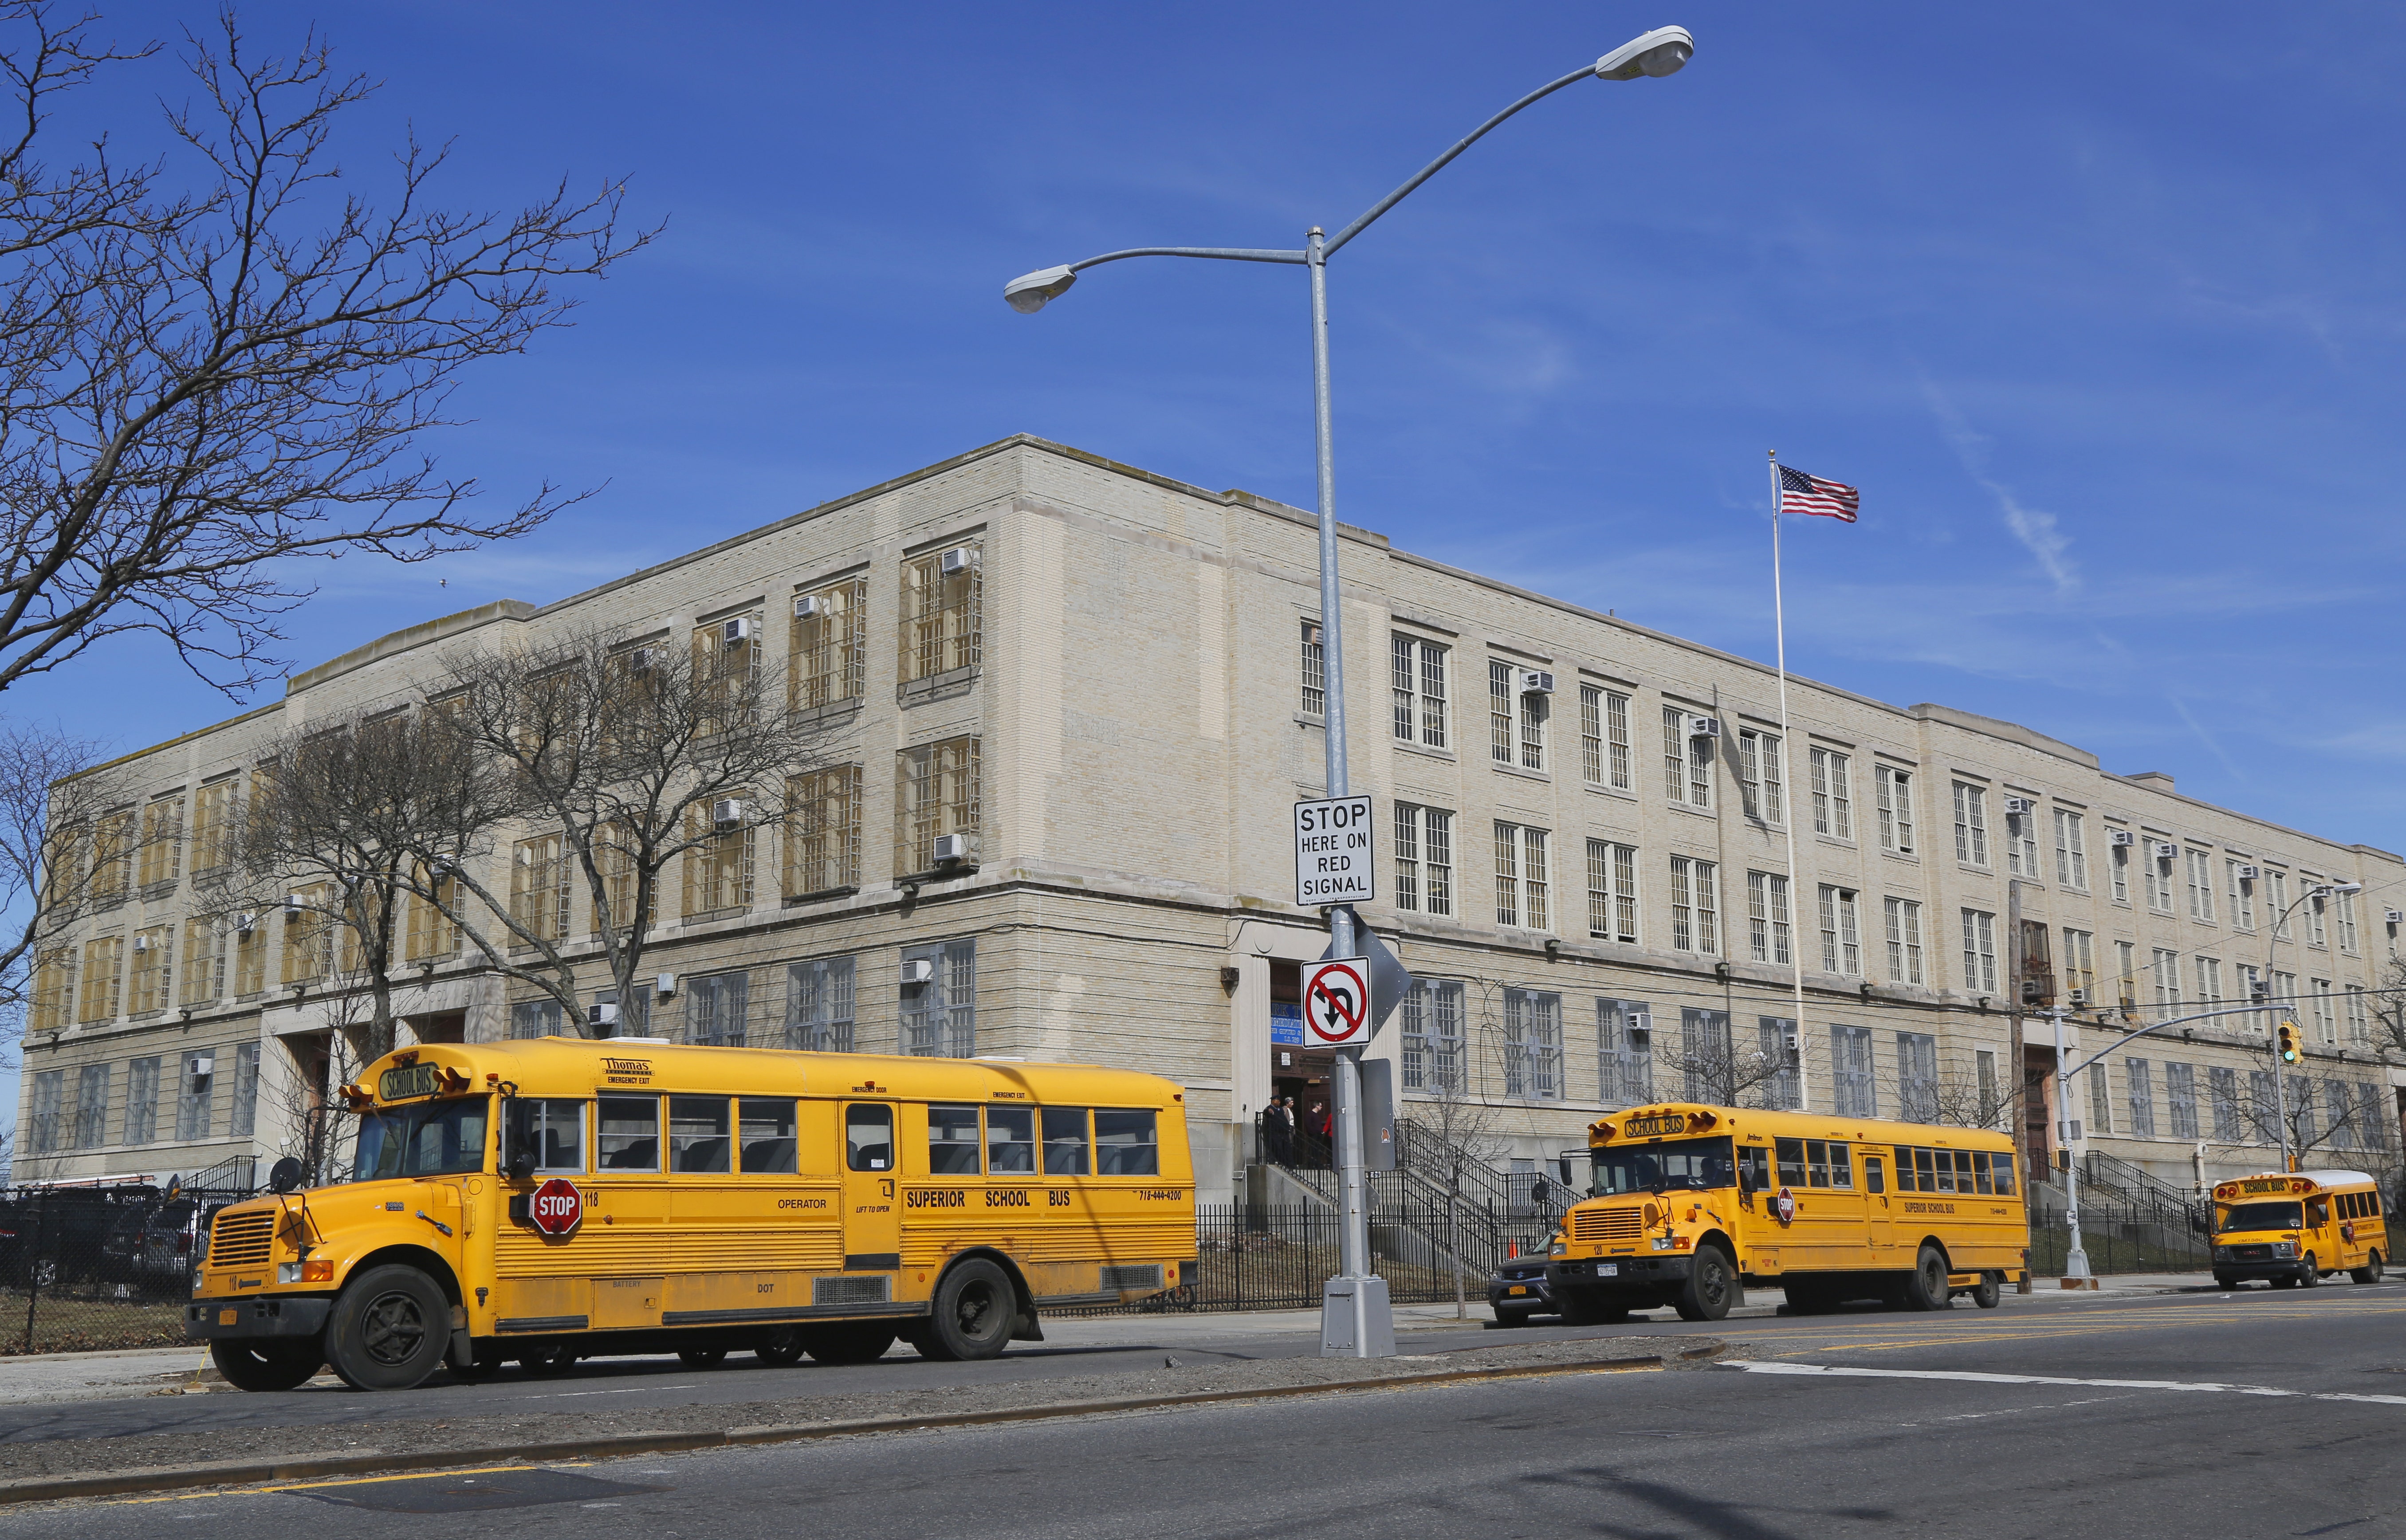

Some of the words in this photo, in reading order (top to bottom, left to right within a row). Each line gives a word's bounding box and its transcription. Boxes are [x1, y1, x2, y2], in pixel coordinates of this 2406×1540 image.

[1301, 804, 1366, 831] STOP
[1302, 835, 1339, 852] HERE
[1347, 832, 1366, 849] ON
[1318, 856, 1350, 872] RED
[1304, 876, 1367, 895] SIGNAL
[601, 1058, 652, 1070] Thomas
[387, 1069, 416, 1097] SCHOOL
[416, 1067, 431, 1093] BUS
[1628, 1119, 1661, 1135] SCHOOL
[1664, 1117, 1682, 1132] BUS
[2245, 1182, 2270, 1193] SCHOOL
[2271, 1181, 2285, 1191] BUS
[539, 1196, 575, 1216] STOP
[585, 1192, 598, 1207] 118
[778, 1199, 826, 1209] OPERATOR
[907, 1191, 965, 1208] SUPERIOR
[986, 1190, 1030, 1207] SCHOOL
[1049, 1190, 1070, 1206] BUS
[1140, 1190, 1181, 1200] 718-444-4200
[1780, 1198, 1793, 1210] STOP
[1905, 1202, 1927, 1213] SUPERIOR
[1928, 1203, 1945, 1214] SCHOOL
[1946, 1204, 1955, 1214] BUS
[758, 1284, 774, 1293] DOT
